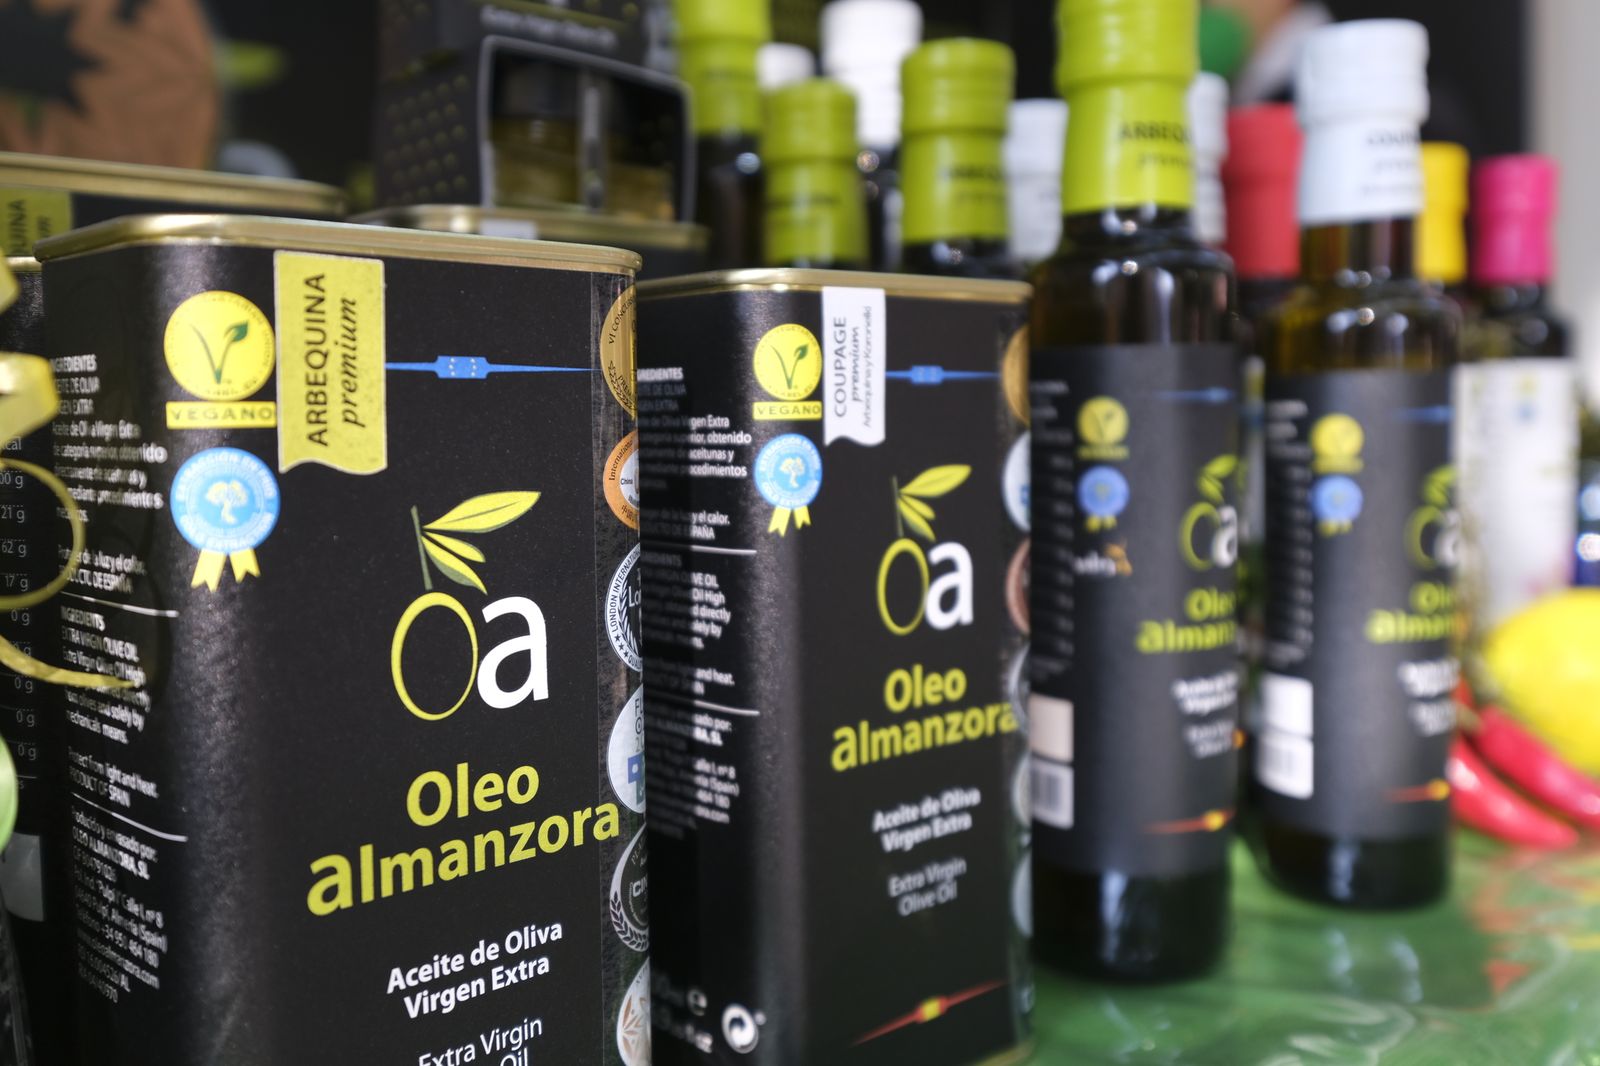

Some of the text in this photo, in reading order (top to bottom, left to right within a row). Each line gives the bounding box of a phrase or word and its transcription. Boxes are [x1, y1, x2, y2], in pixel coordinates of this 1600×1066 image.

[304, 273, 329, 447] ARBEQUINA
[335, 297, 366, 429] premium
[833, 316, 847, 418] COUPAGE
[849, 326, 864, 403] premium
[171, 408, 273, 422] VEGANO
[706, 414, 730, 428] Extra
[757, 404, 821, 416] VEGANO
[707, 430, 752, 445] obtenido
[727, 449, 734, 463] y
[609, 600, 619, 633] LONDON
[884, 663, 967, 714] Oleo
[831, 701, 1018, 772] almanzora
[406, 762, 540, 827] Oleo
[872, 787, 982, 832] Aceite de Oliva
[880, 811, 973, 852] Virgen Extra
[306, 802, 620, 916] almanzora
[888, 856, 967, 898] Extra Virgin
[898, 879, 958, 917] Olive Oil
[386, 922, 563, 994] Aceite de Oliva
[403, 957, 550, 1019] Virgen Extra
[418, 1018, 543, 1066] Extra Virgin
